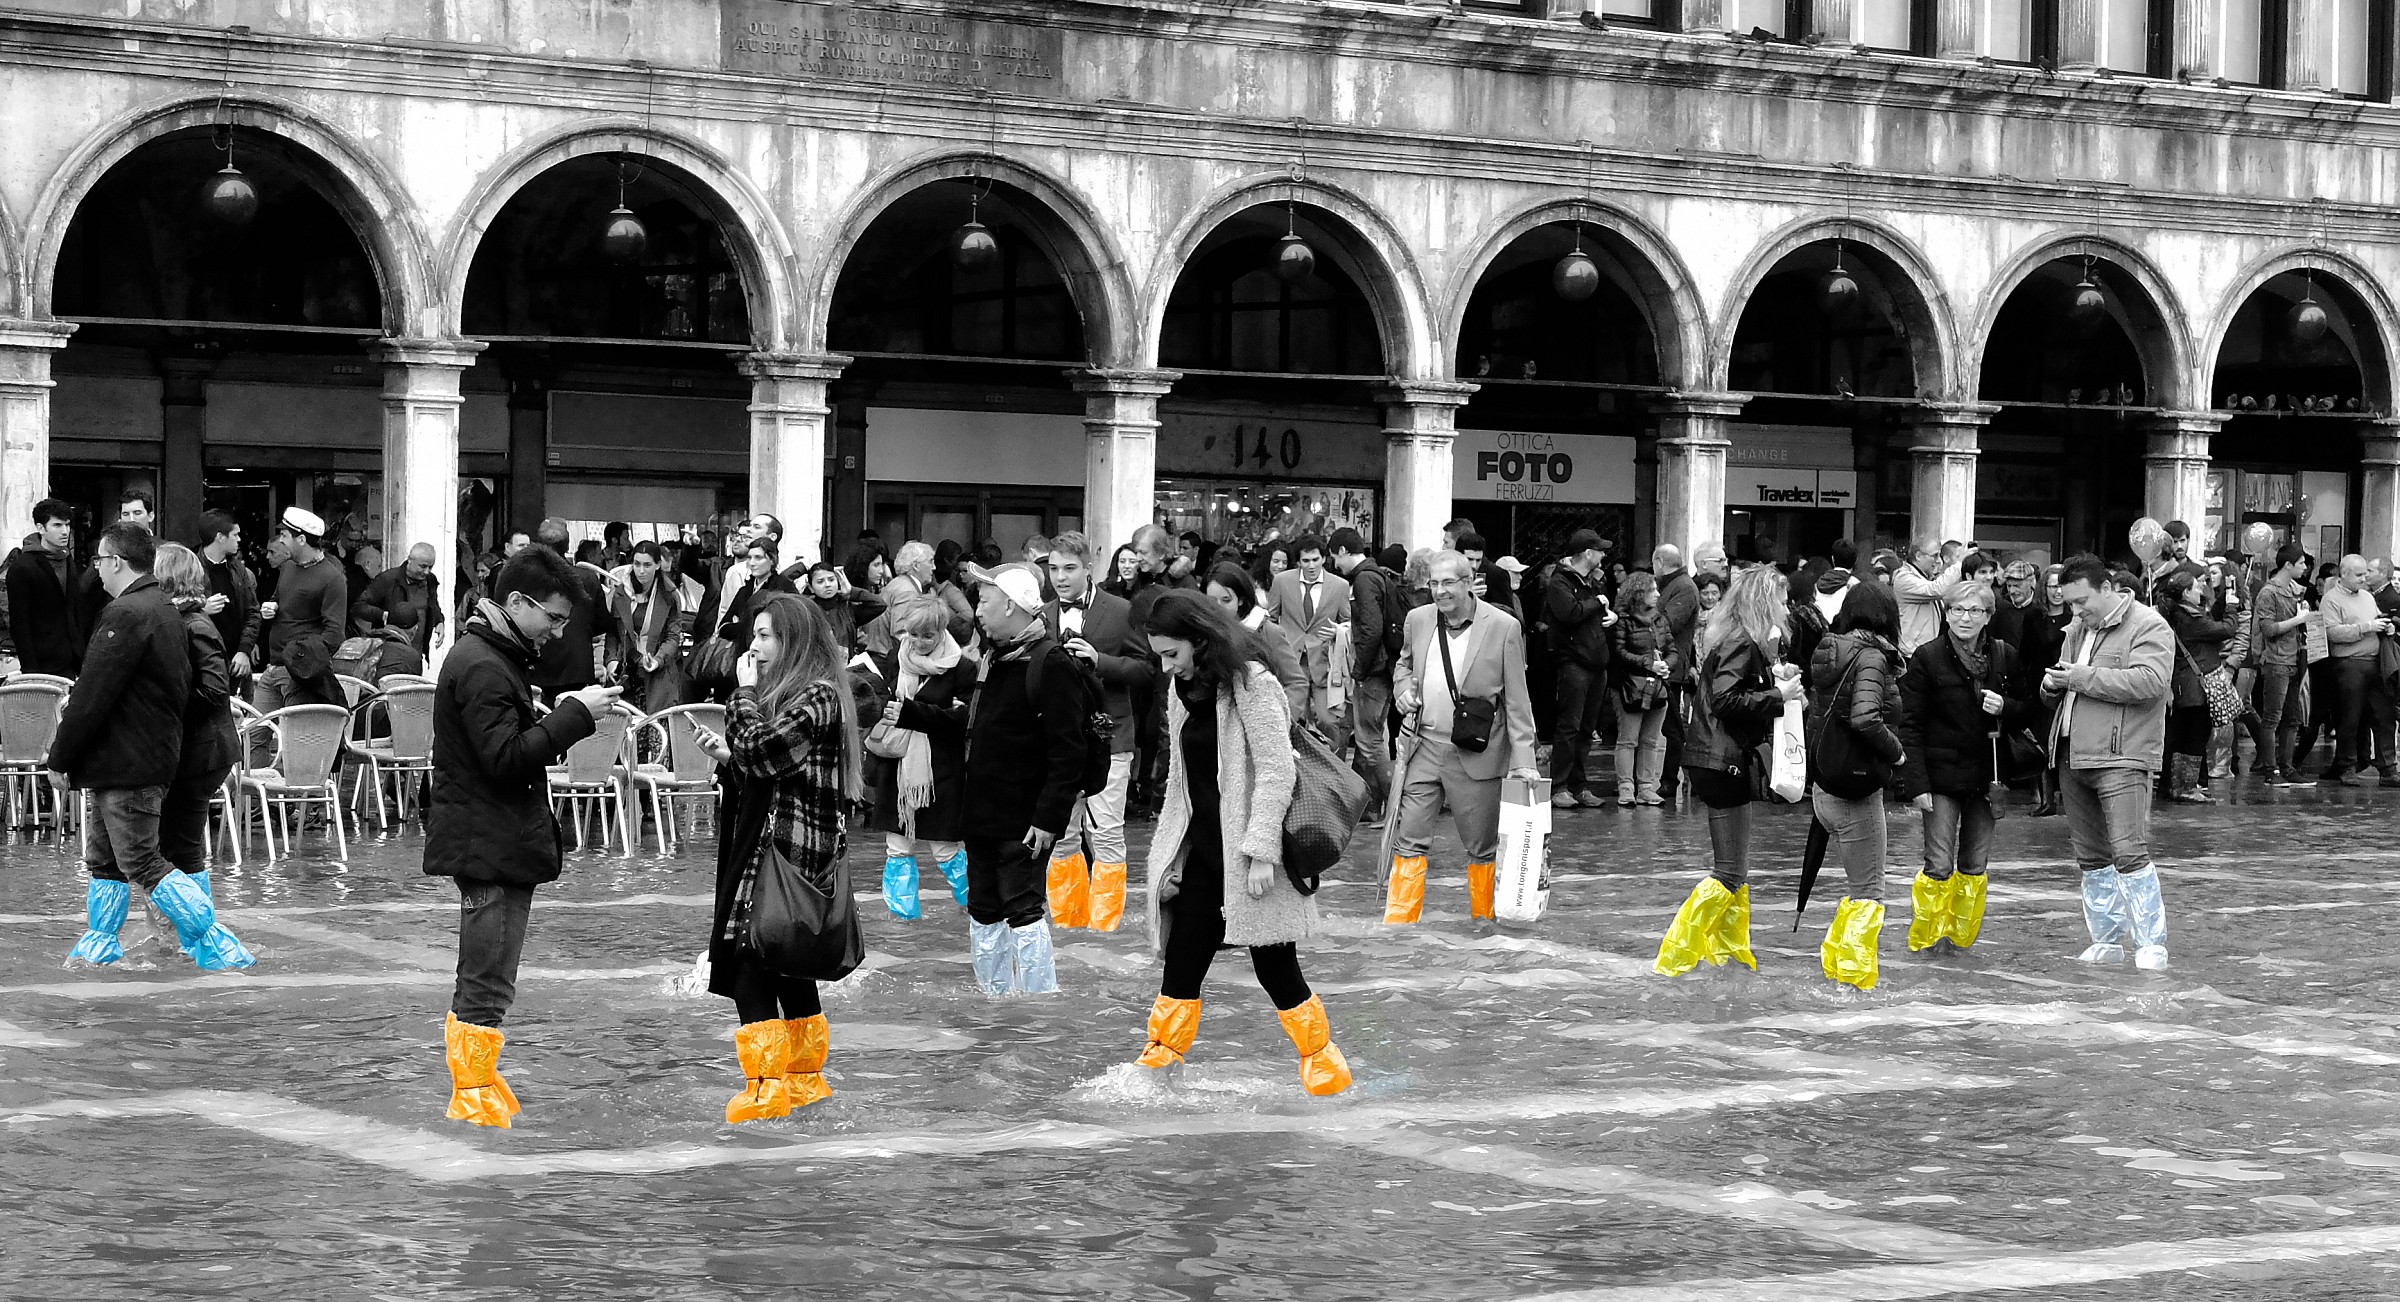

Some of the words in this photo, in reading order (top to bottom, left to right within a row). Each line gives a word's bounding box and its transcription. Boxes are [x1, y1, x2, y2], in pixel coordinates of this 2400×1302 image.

[846, 14, 948, 36] GARIBALDI
[747, 21, 778, 37] QUI
[789, 26, 892, 48] SALUTANDO
[900, 36, 972, 56] VENEZIA
[981, 43, 1041, 62] LIBERA
[819, 45, 867, 63] ROMA
[877, 51, 960, 71] CAPITALE
[1233, 422, 1302, 469] 140
[1497, 432, 1554, 451] OTTICA
[1726, 447, 1789, 461] CHANGE
[1477, 451, 1573, 483] FOTO
[1496, 483, 1554, 501] FERRUZZI
[1756, 484, 1814, 503] Travelex
[1820, 497, 1841, 505] money
[1515, 821, 1533, 907] www.longonisport.it
